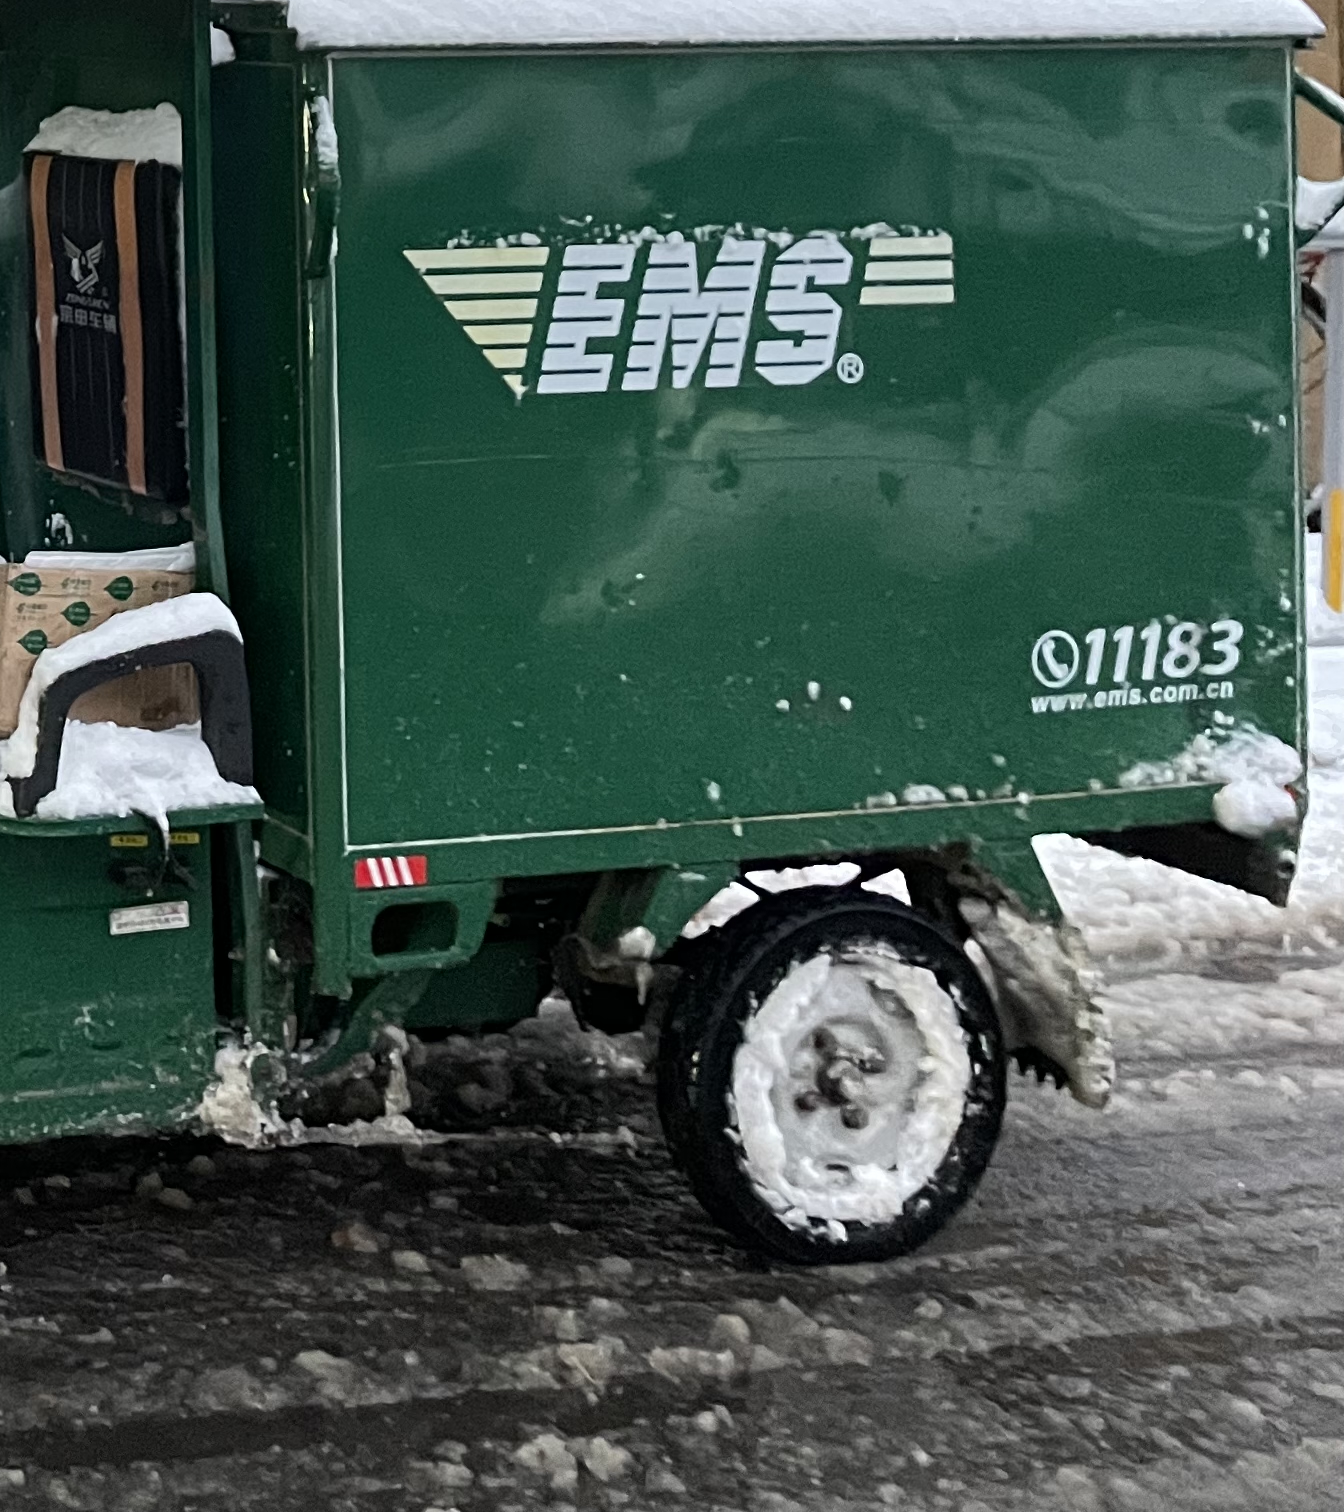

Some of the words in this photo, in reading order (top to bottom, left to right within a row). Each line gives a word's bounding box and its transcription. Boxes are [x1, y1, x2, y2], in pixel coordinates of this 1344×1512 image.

[537, 238, 853, 394] EMS
[1085, 619, 1244, 685] 11183
[1030, 680, 1234, 714] www.ems.com.cn
